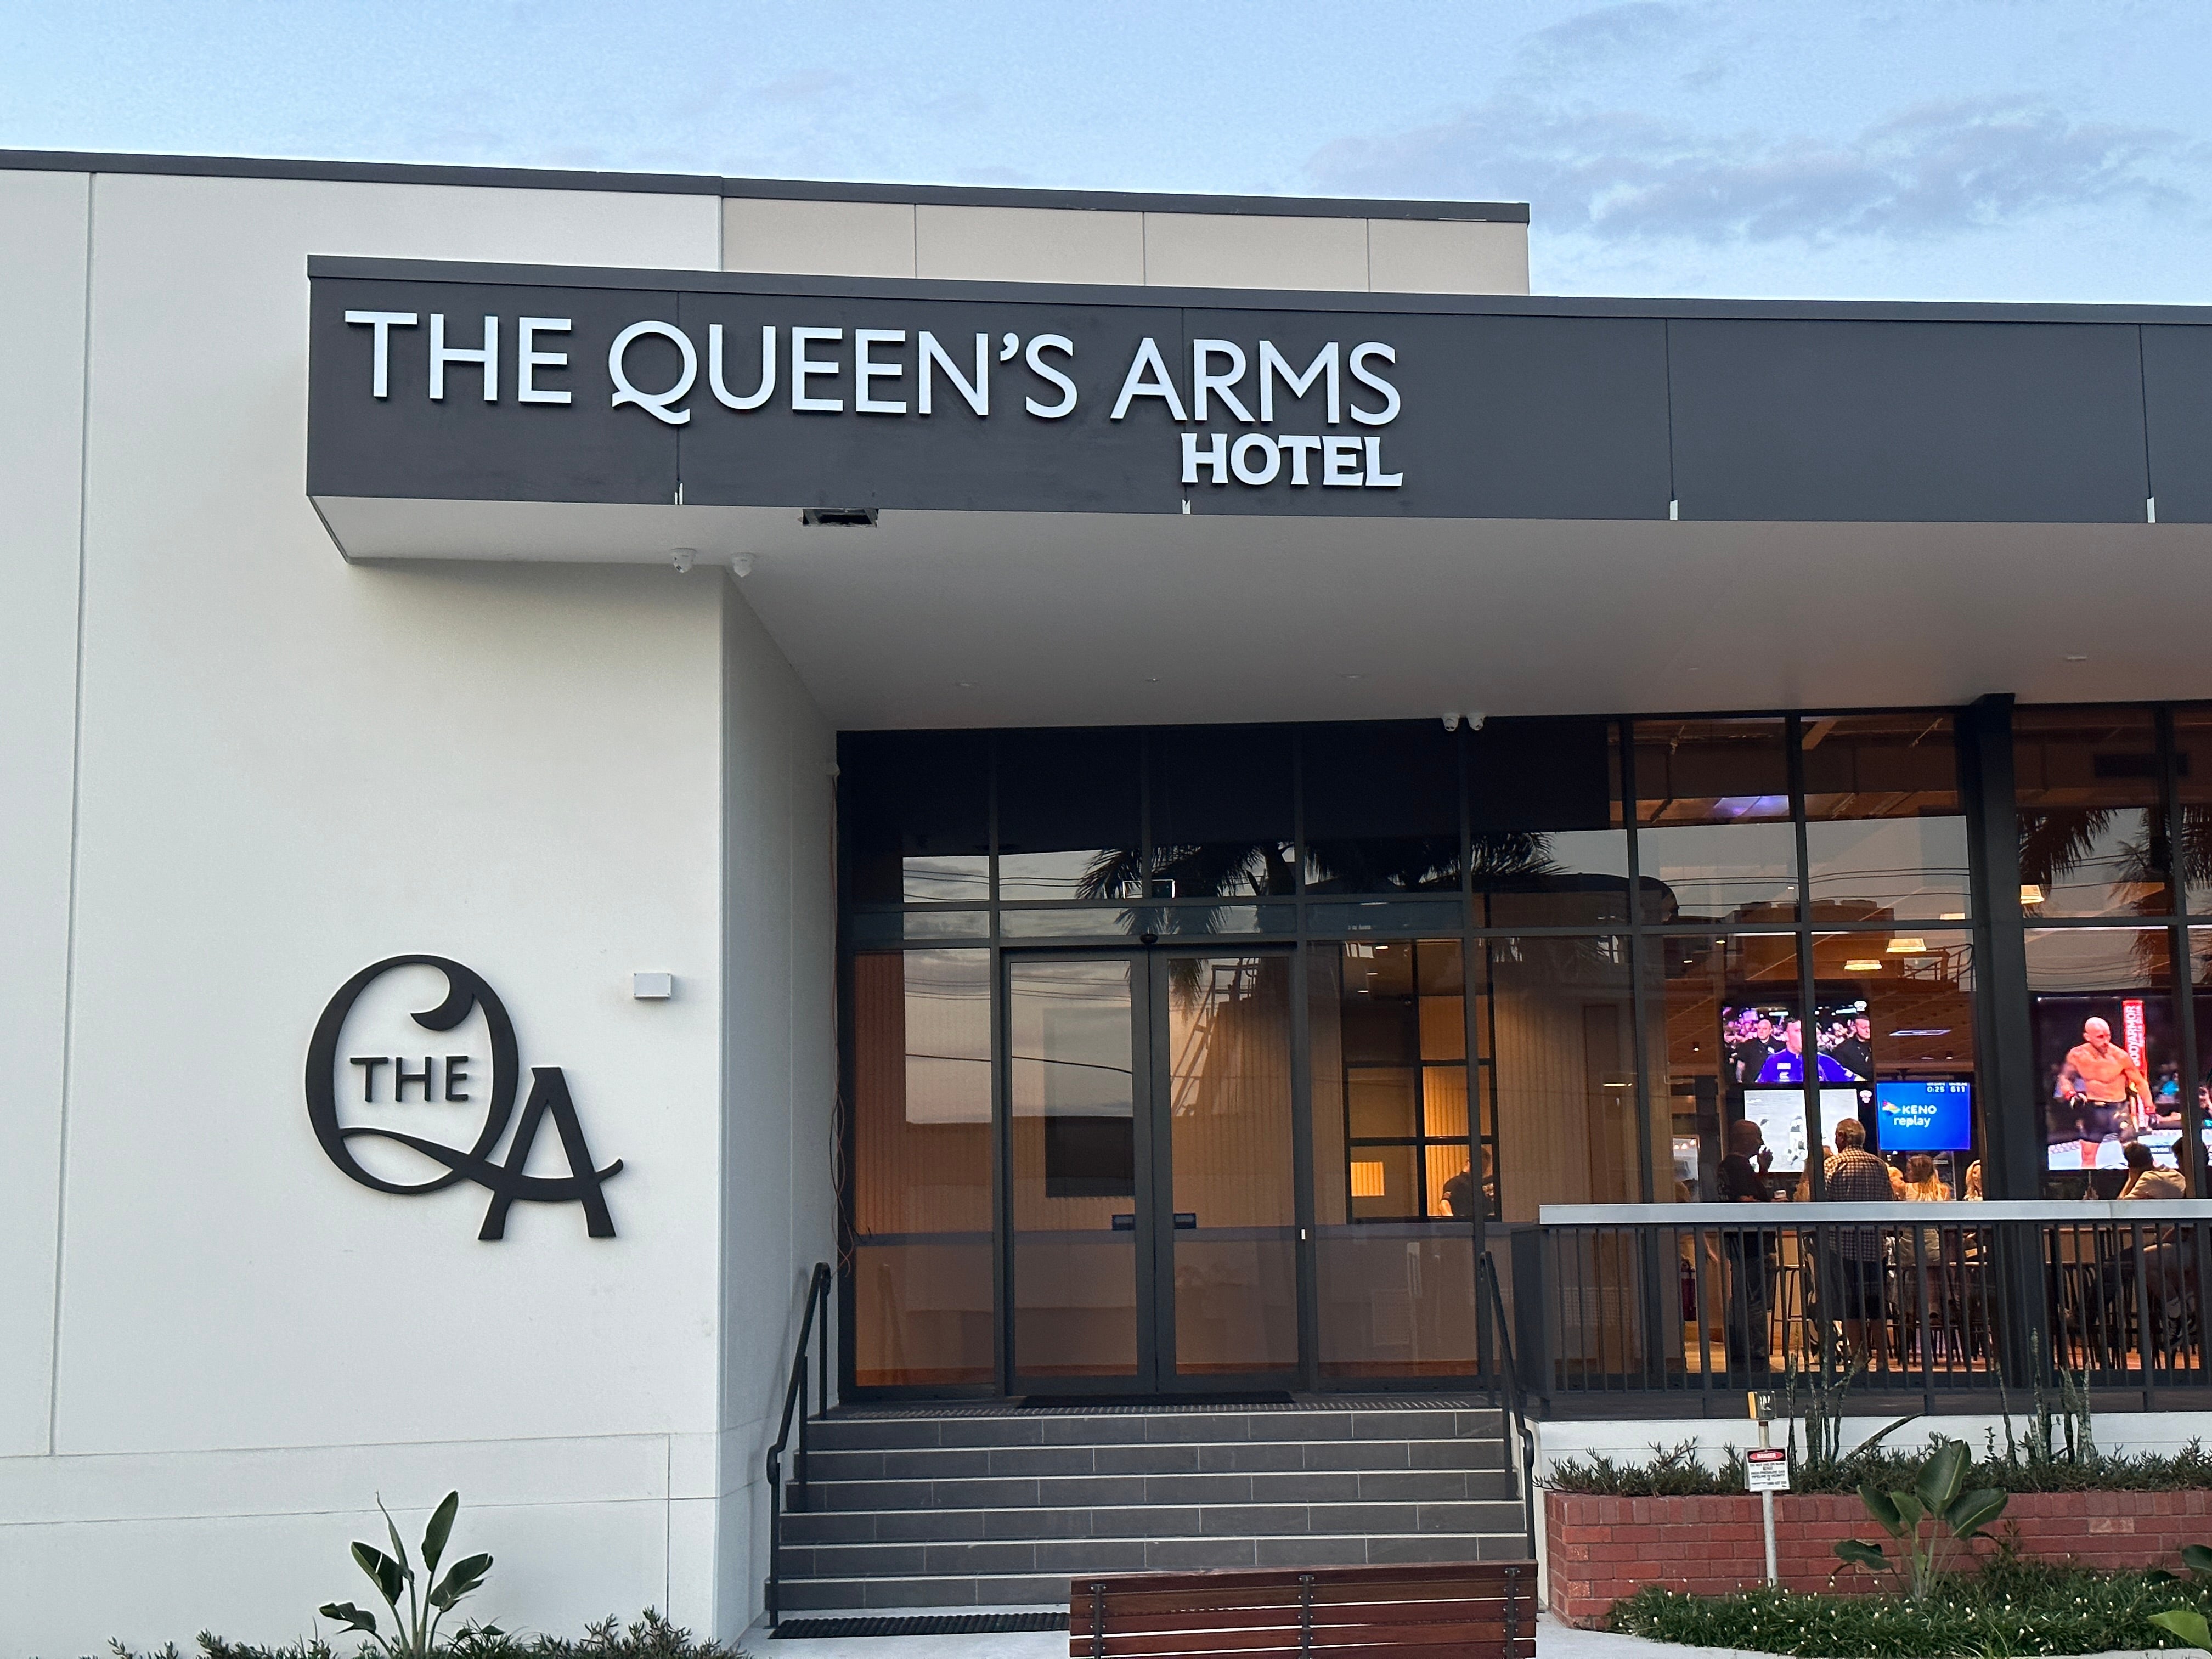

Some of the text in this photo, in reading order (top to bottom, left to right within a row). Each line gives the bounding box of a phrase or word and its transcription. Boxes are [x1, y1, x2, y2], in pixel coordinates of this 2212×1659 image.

[345, 310, 1401, 425] THE QUEEN'S ARMS
[1181, 433, 1403, 487] HOTEL
[349, 1056, 469, 1103] THE
[1894, 1115, 1931, 1128] replay
[1902, 1105, 1937, 1114] KENO
